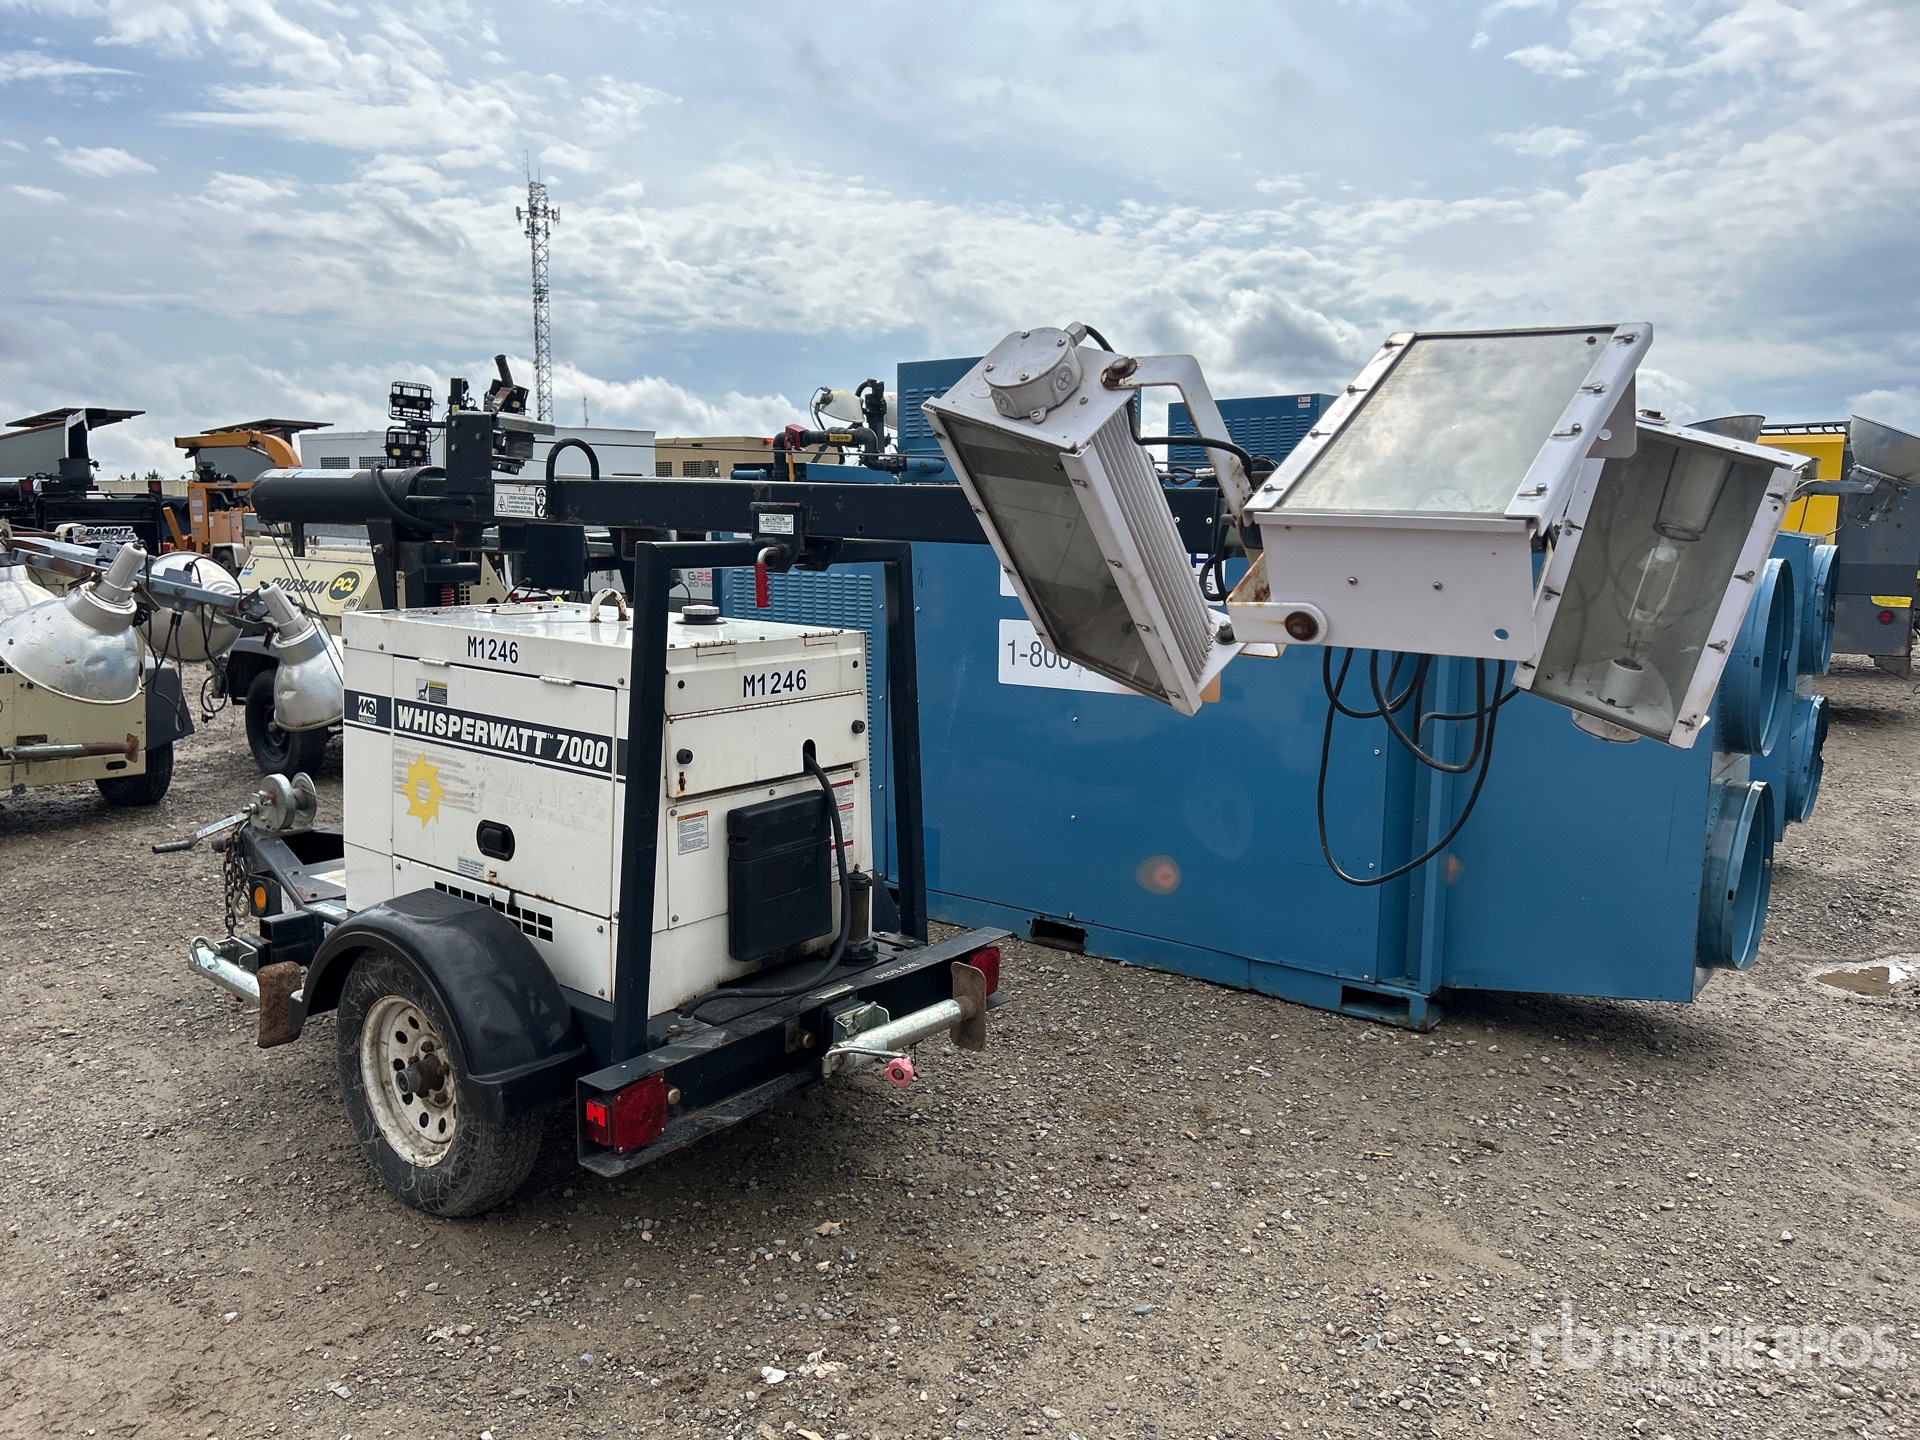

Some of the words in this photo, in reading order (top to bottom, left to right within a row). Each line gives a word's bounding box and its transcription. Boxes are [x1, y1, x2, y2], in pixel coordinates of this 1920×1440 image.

[86, 528, 132, 536] BANDIT
[332, 576, 356, 592] PCL
[468, 635, 518, 664] M1246
[743, 669, 807, 698] M1246
[556, 733, 609, 768] 7000
